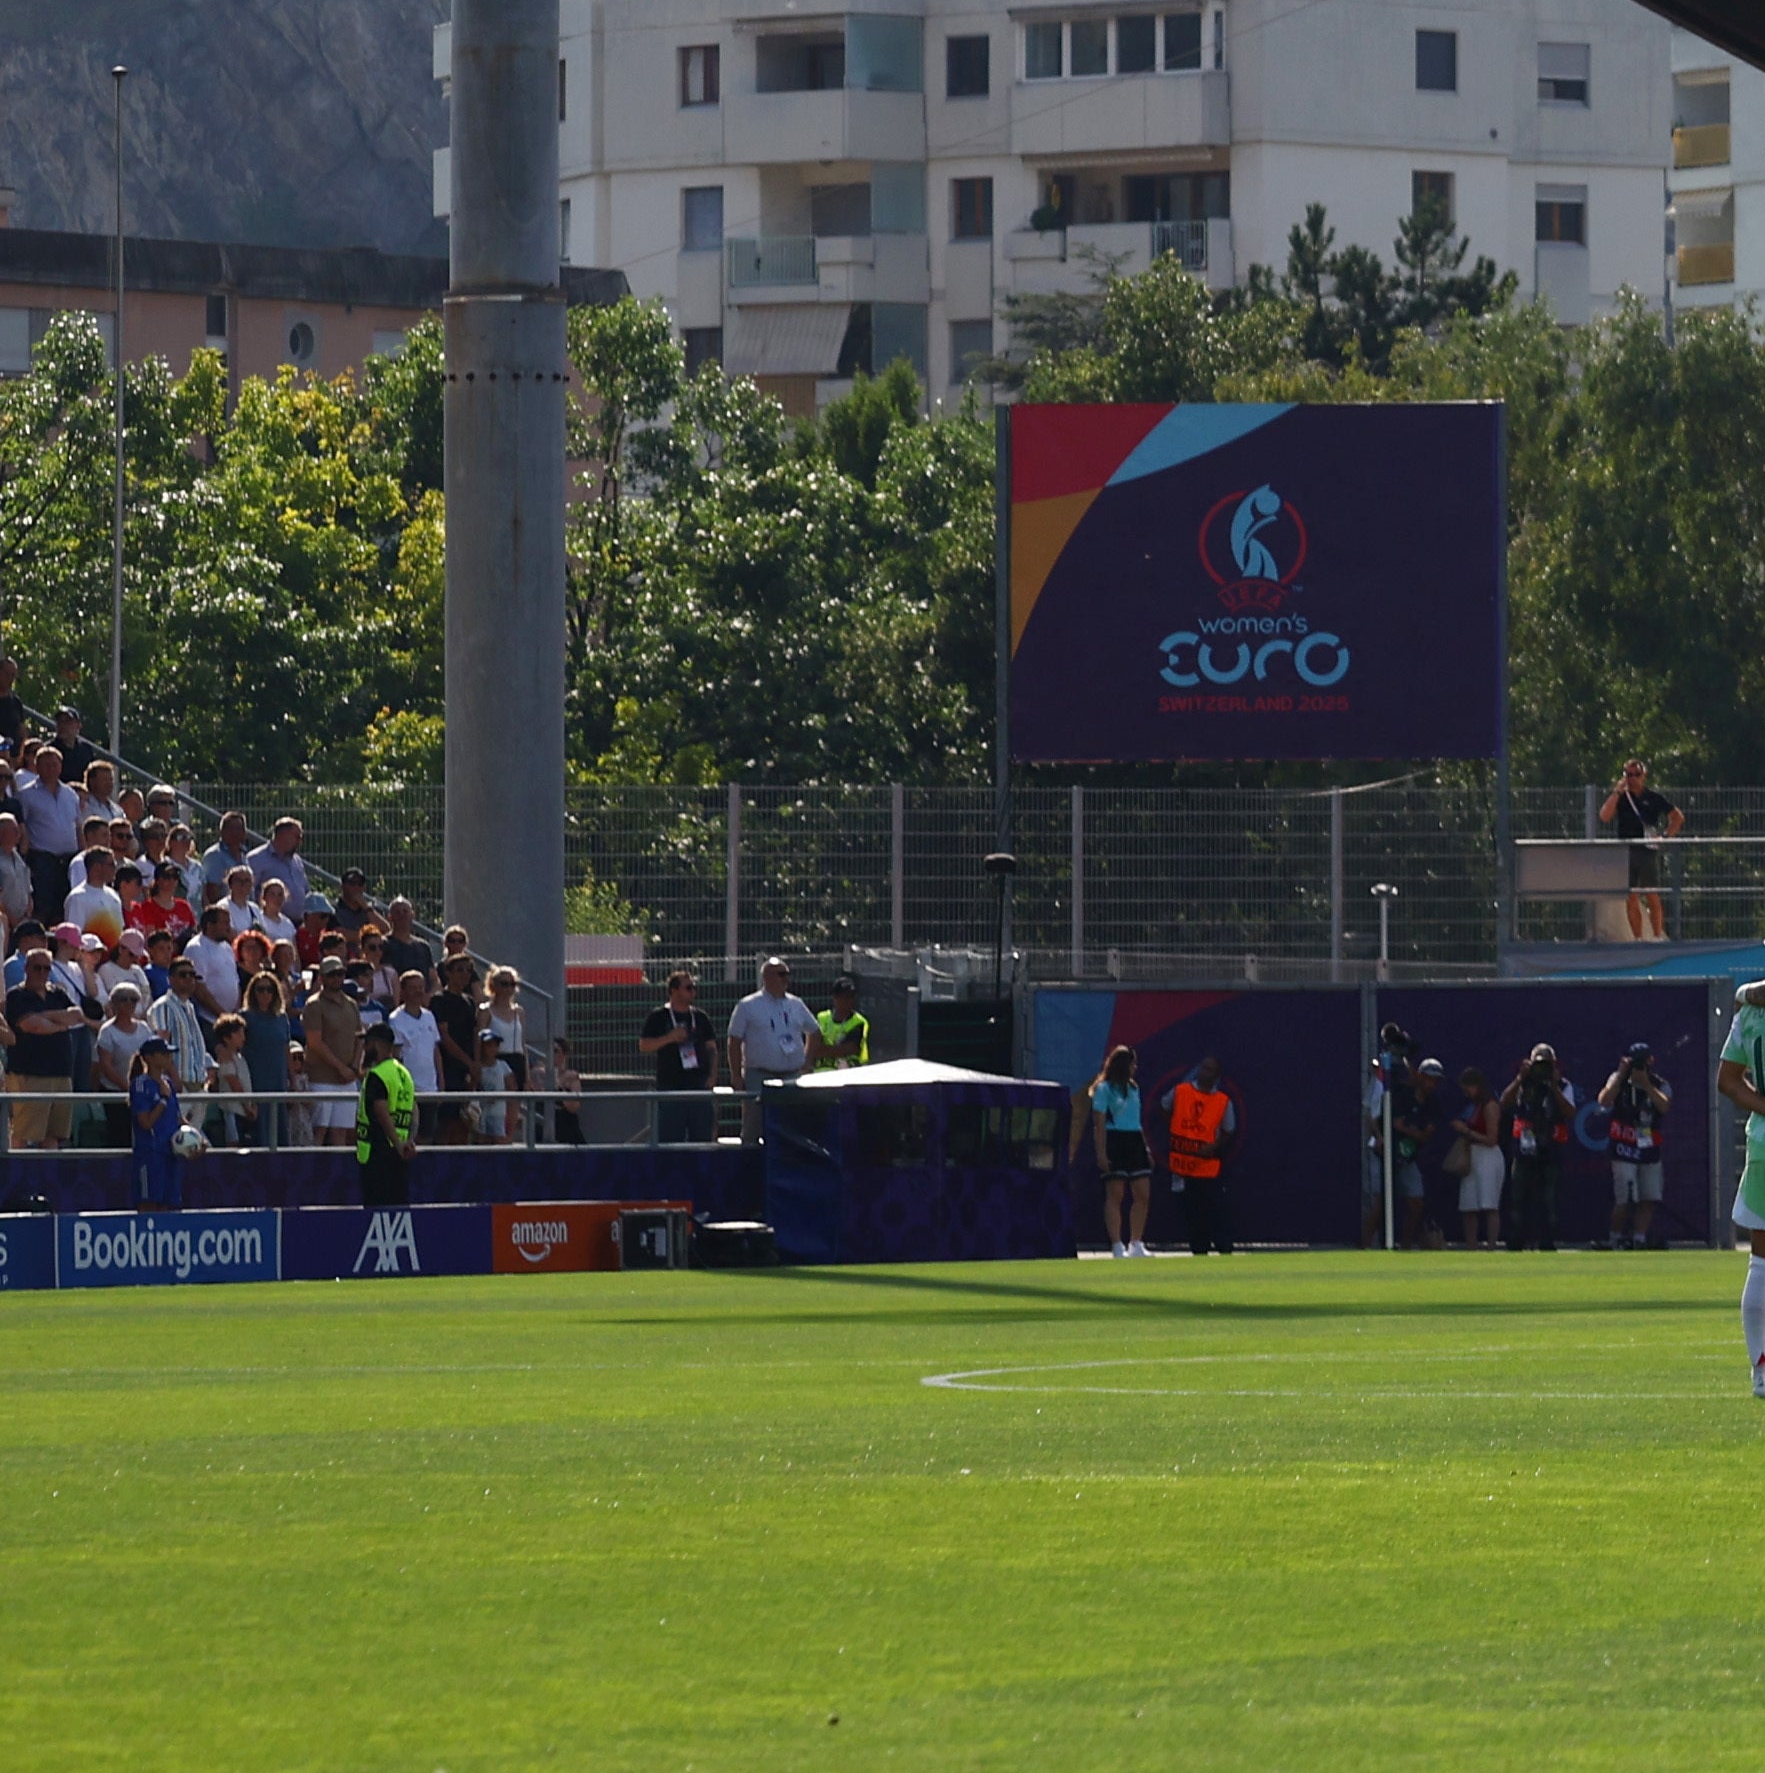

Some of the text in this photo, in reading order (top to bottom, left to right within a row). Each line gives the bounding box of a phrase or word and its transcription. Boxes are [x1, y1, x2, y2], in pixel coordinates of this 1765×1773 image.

[1219, 584, 1285, 610] UEFA
[1198, 612, 1309, 634] women's
[1158, 695, 1349, 713] SWITZERLAND 2025
[352, 1212, 421, 1272] AXA
[511, 1220, 568, 1244] amazon
[74, 1218, 262, 1279] Booking.com
